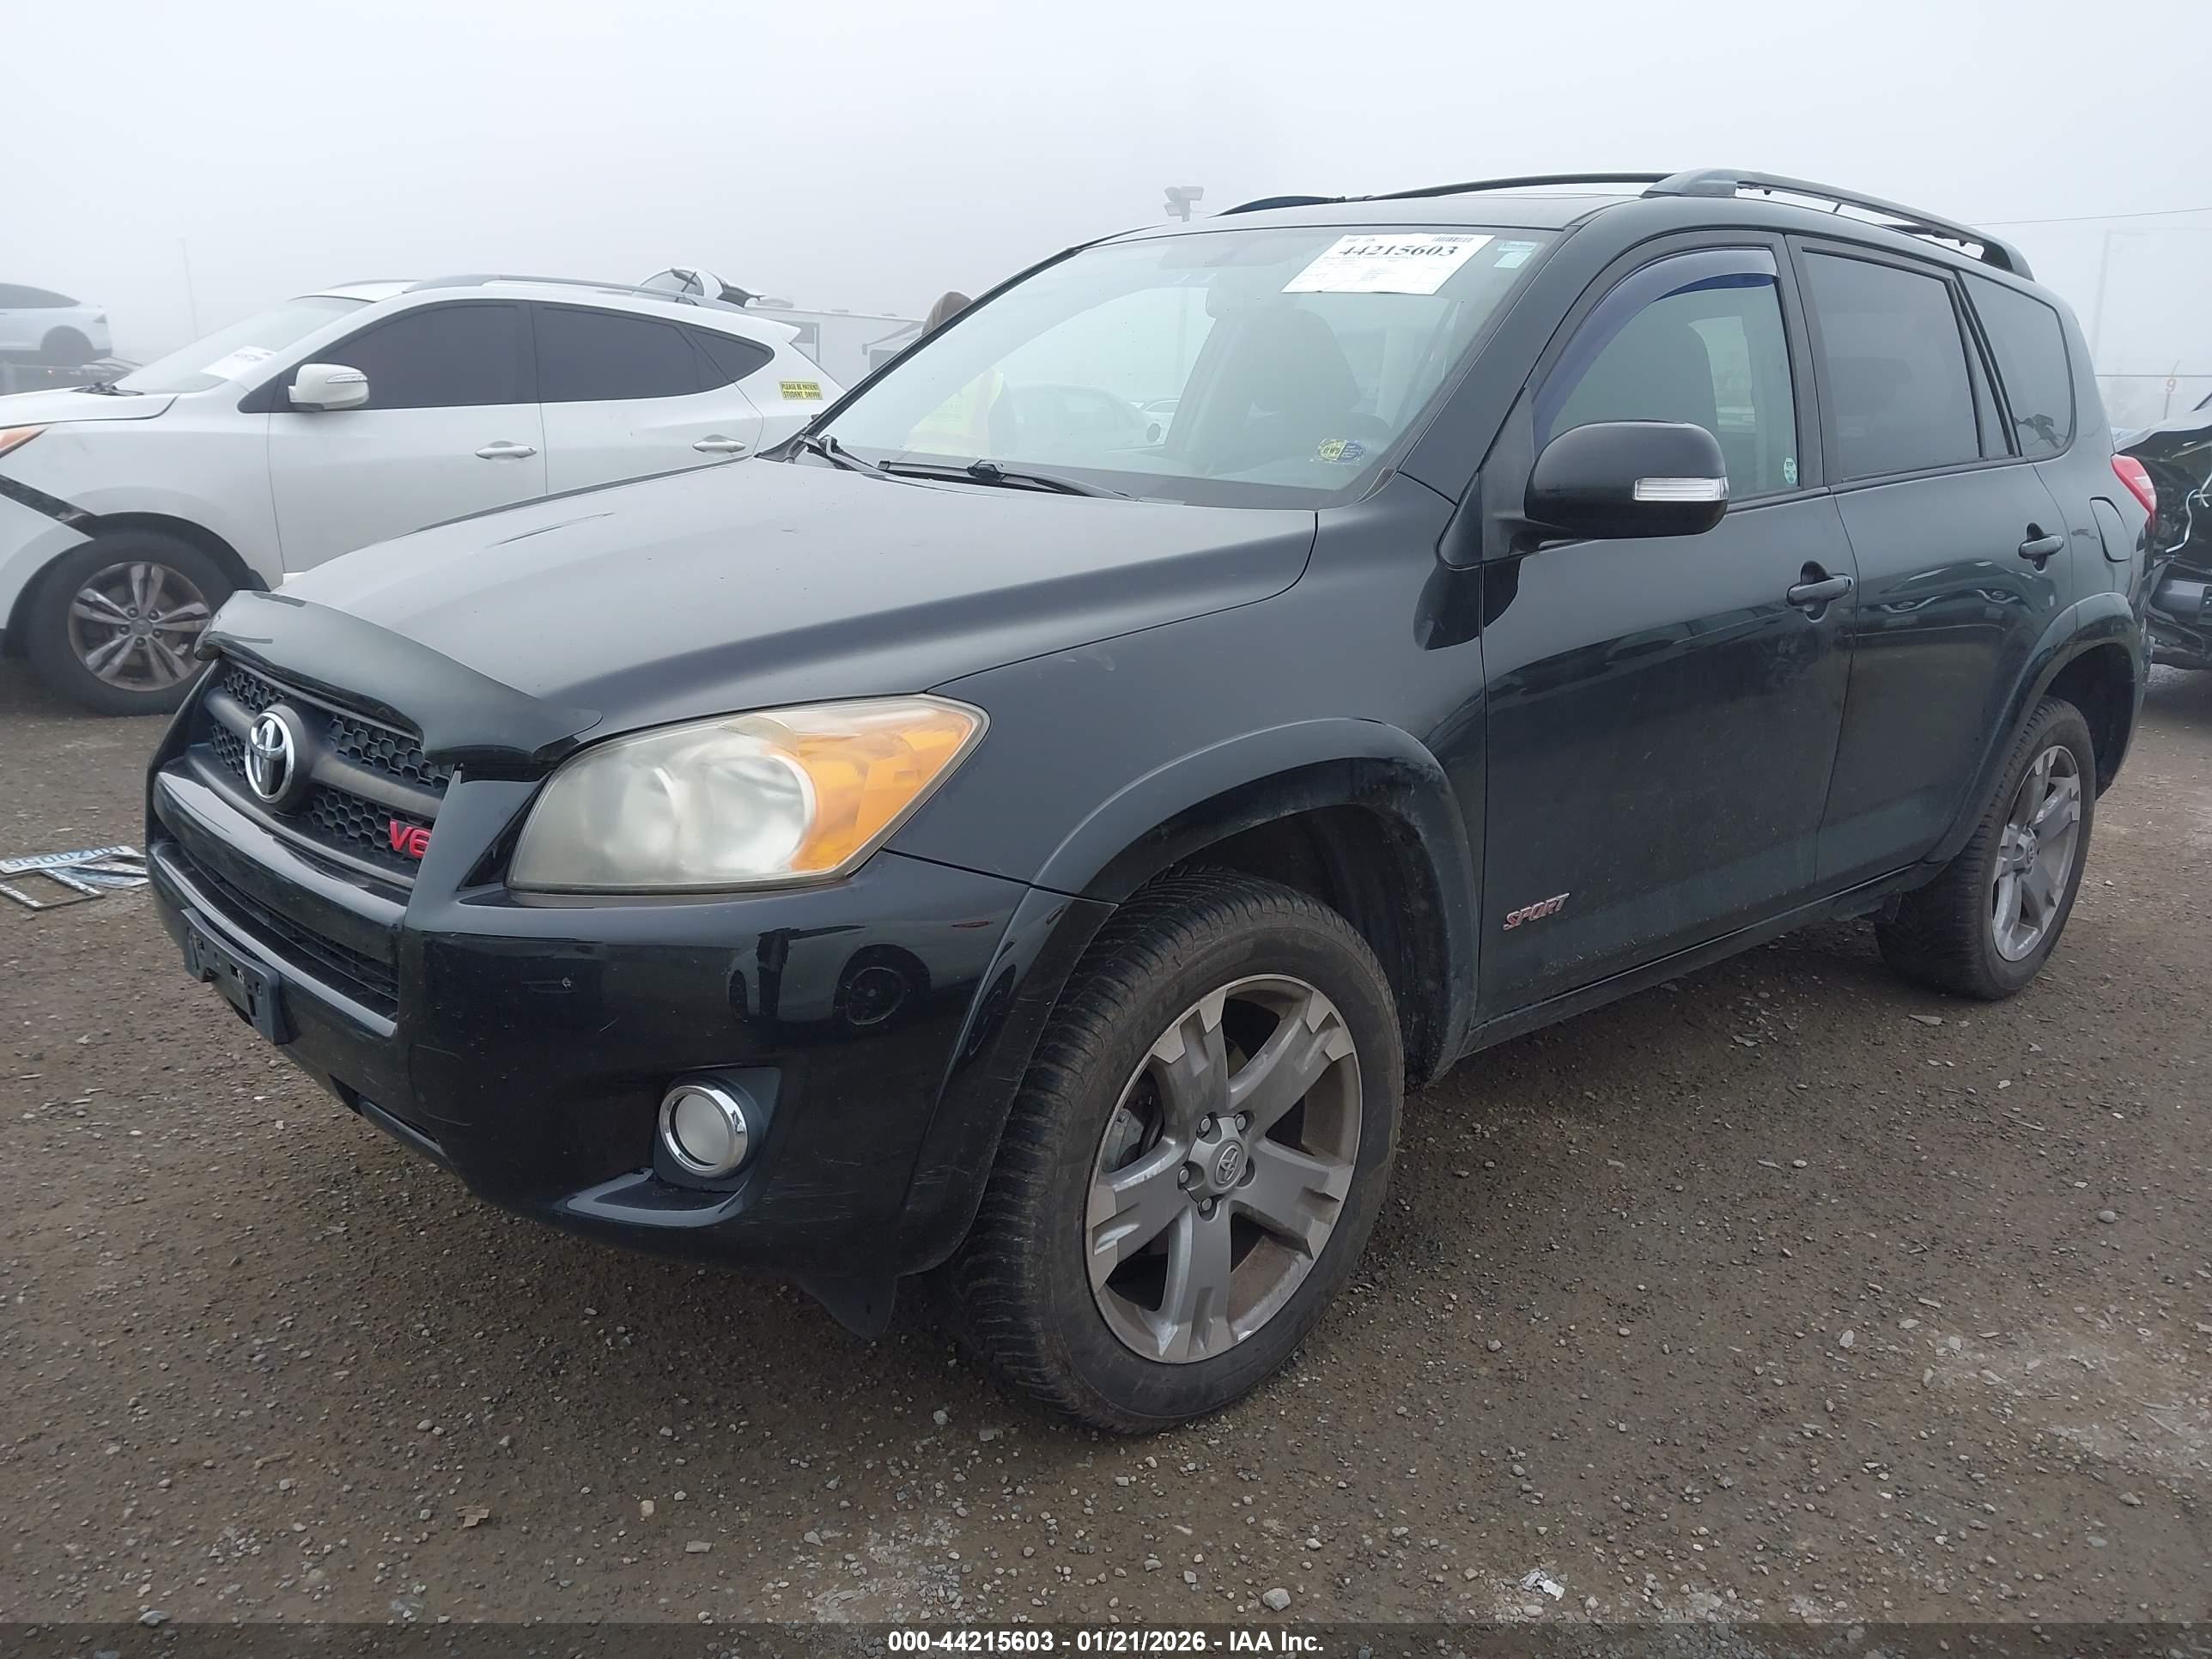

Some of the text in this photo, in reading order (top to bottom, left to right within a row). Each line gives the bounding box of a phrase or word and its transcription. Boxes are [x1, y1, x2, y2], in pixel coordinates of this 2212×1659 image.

[1339, 245, 1459, 257] 44215603
[389, 818, 431, 859] V6
[1503, 892, 1571, 931] SPORT
